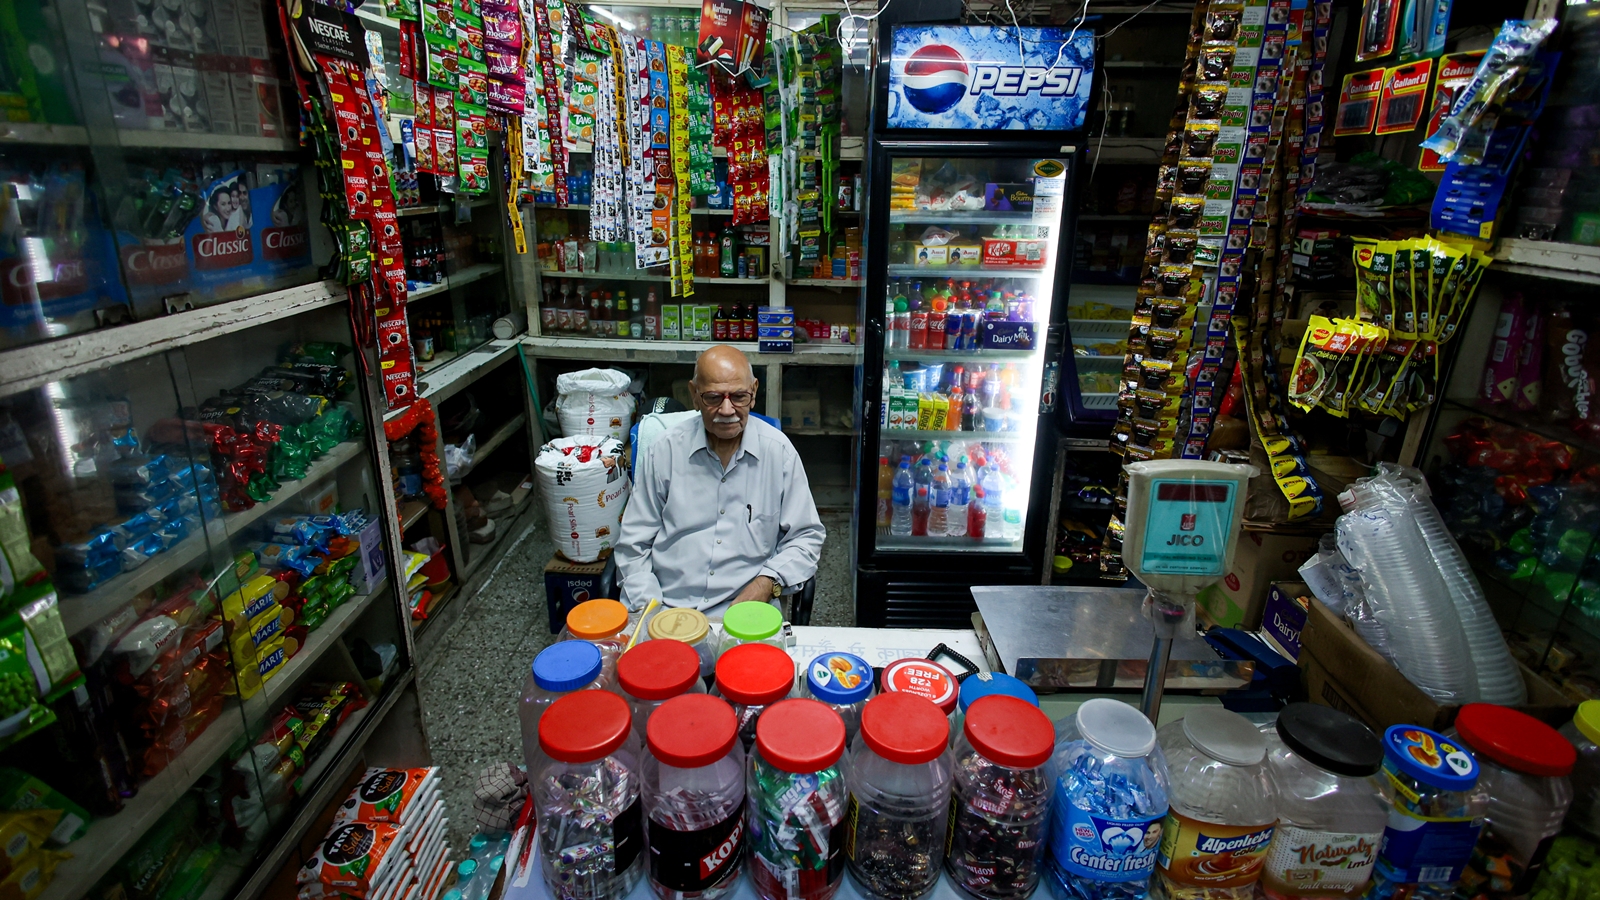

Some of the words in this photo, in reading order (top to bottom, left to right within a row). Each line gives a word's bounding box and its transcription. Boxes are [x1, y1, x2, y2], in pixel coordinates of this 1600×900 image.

[971, 66, 1082, 96] PEPSI
[1442, 66, 1477, 77] Gallan
[573, 81, 594, 93] TANG
[573, 114, 592, 125] TANG
[539, 164, 553, 173] TAN
[198, 238, 249, 258] Classic
[992, 334, 1012, 344] Dairy
[1166, 534, 1204, 547] JICO
[567, 580, 592, 589] pepsi
[248, 592, 274, 617] MARIE
[254, 616, 280, 642] MARIE
[1273, 612, 1298, 643] Dairy
[259, 648, 285, 674] MARIE
[365, 773, 388, 796] TATA
[328, 826, 355, 856] TATA
[342, 831, 363, 855] Salt
[703, 815, 745, 872] KOPI
[1201, 829, 1272, 855] Alpenliebe
[1070, 846, 1121, 872] Center
[1123, 850, 1157, 872] fresh
[1322, 881, 1355, 893] candy
